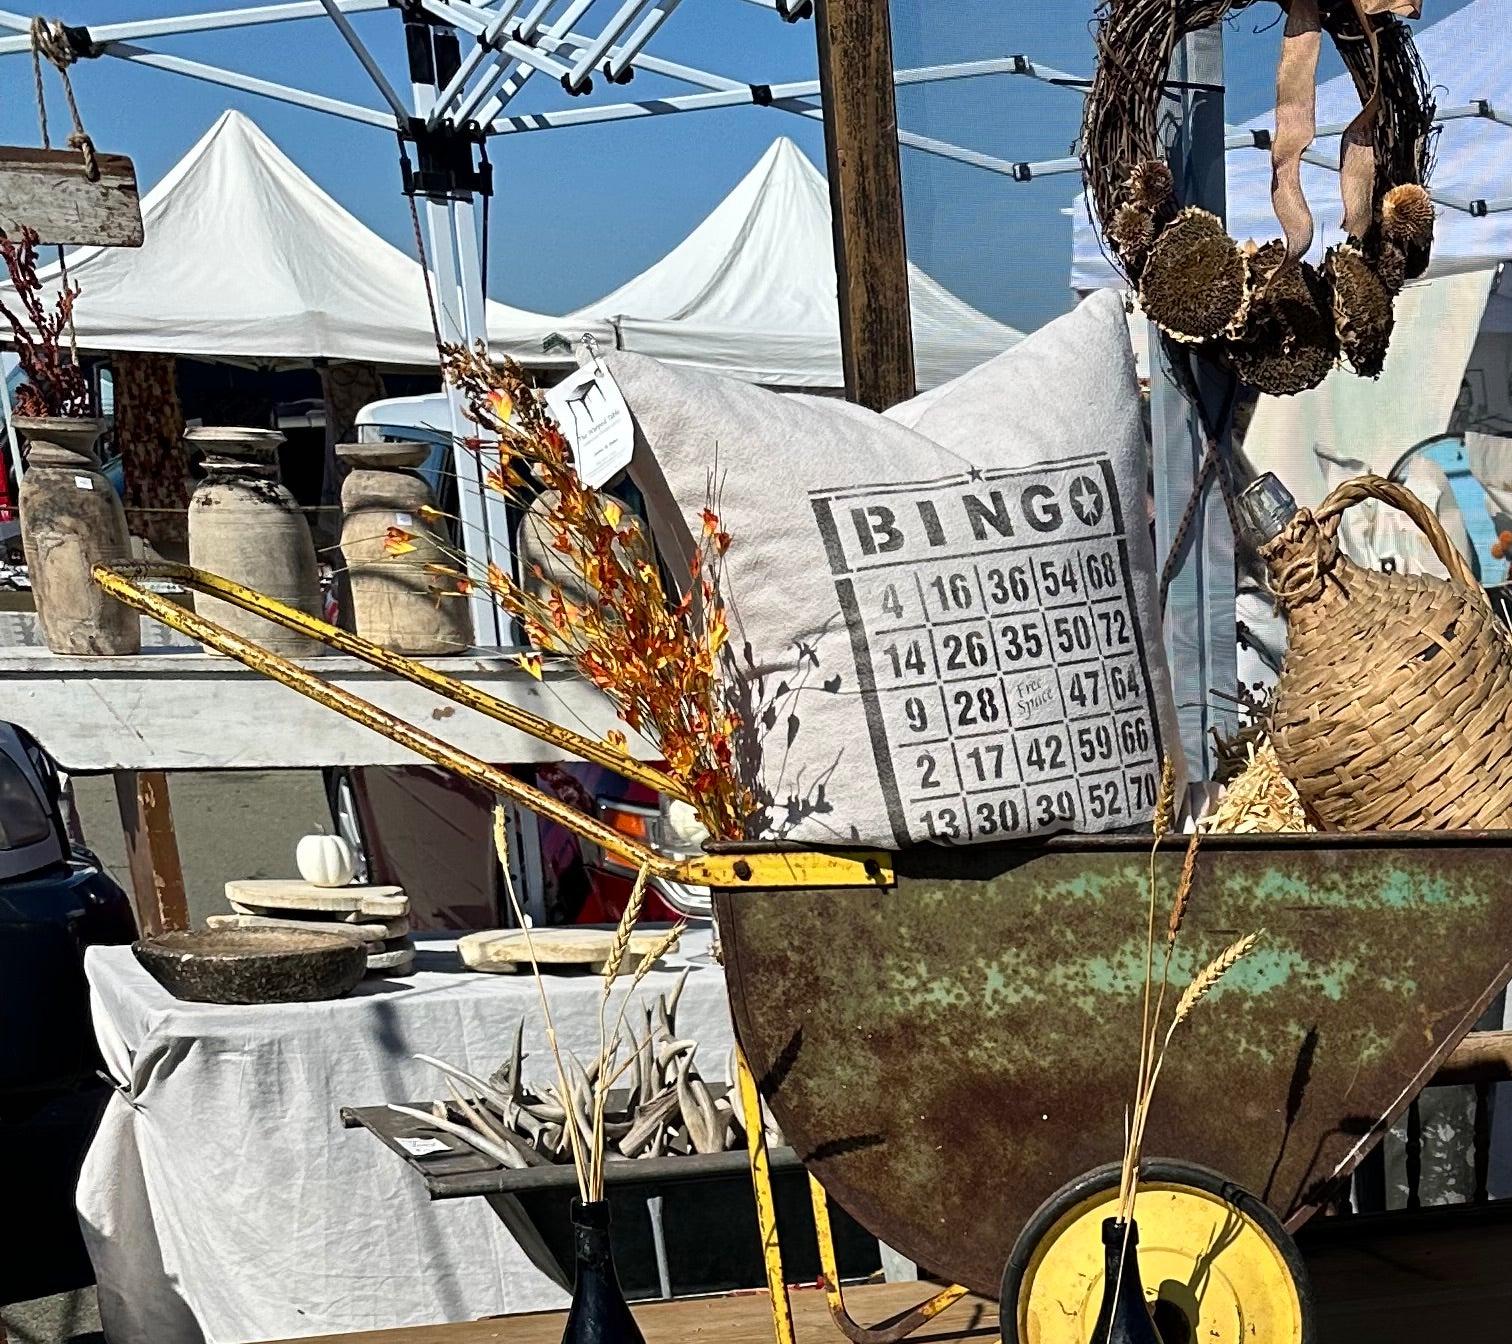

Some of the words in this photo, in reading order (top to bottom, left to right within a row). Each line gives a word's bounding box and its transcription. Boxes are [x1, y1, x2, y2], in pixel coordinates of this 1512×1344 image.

[850, 475, 1104, 555] BINGO
[881, 584, 904, 619] 4
[931, 573, 972, 612] 16
[988, 565, 1029, 604] 36
[1041, 557, 1078, 597] 54
[1086, 550, 1116, 591] 68
[884, 640, 926, 678] 14
[944, 630, 988, 671] 26
[1002, 623, 1042, 661] 35
[1057, 615, 1092, 653] 50
[1099, 609, 1130, 647] 72
[904, 696, 928, 733] 9
[954, 688, 999, 726] 28
[1070, 671, 1100, 708] 47
[1112, 664, 1140, 700] 64
[1016, 678, 1042, 698] Free
[1017, 687, 1053, 720] Space
[916, 754, 941, 790] 2
[967, 744, 1003, 781] 17
[1027, 735, 1066, 772] 42
[1079, 725, 1112, 763] 59
[1121, 717, 1148, 755] 66
[919, 808, 961, 841] 13
[977, 798, 1019, 835] 30
[1036, 789, 1076, 826] 39
[1089, 781, 1122, 819] 52
[1130, 773, 1156, 810] 70
